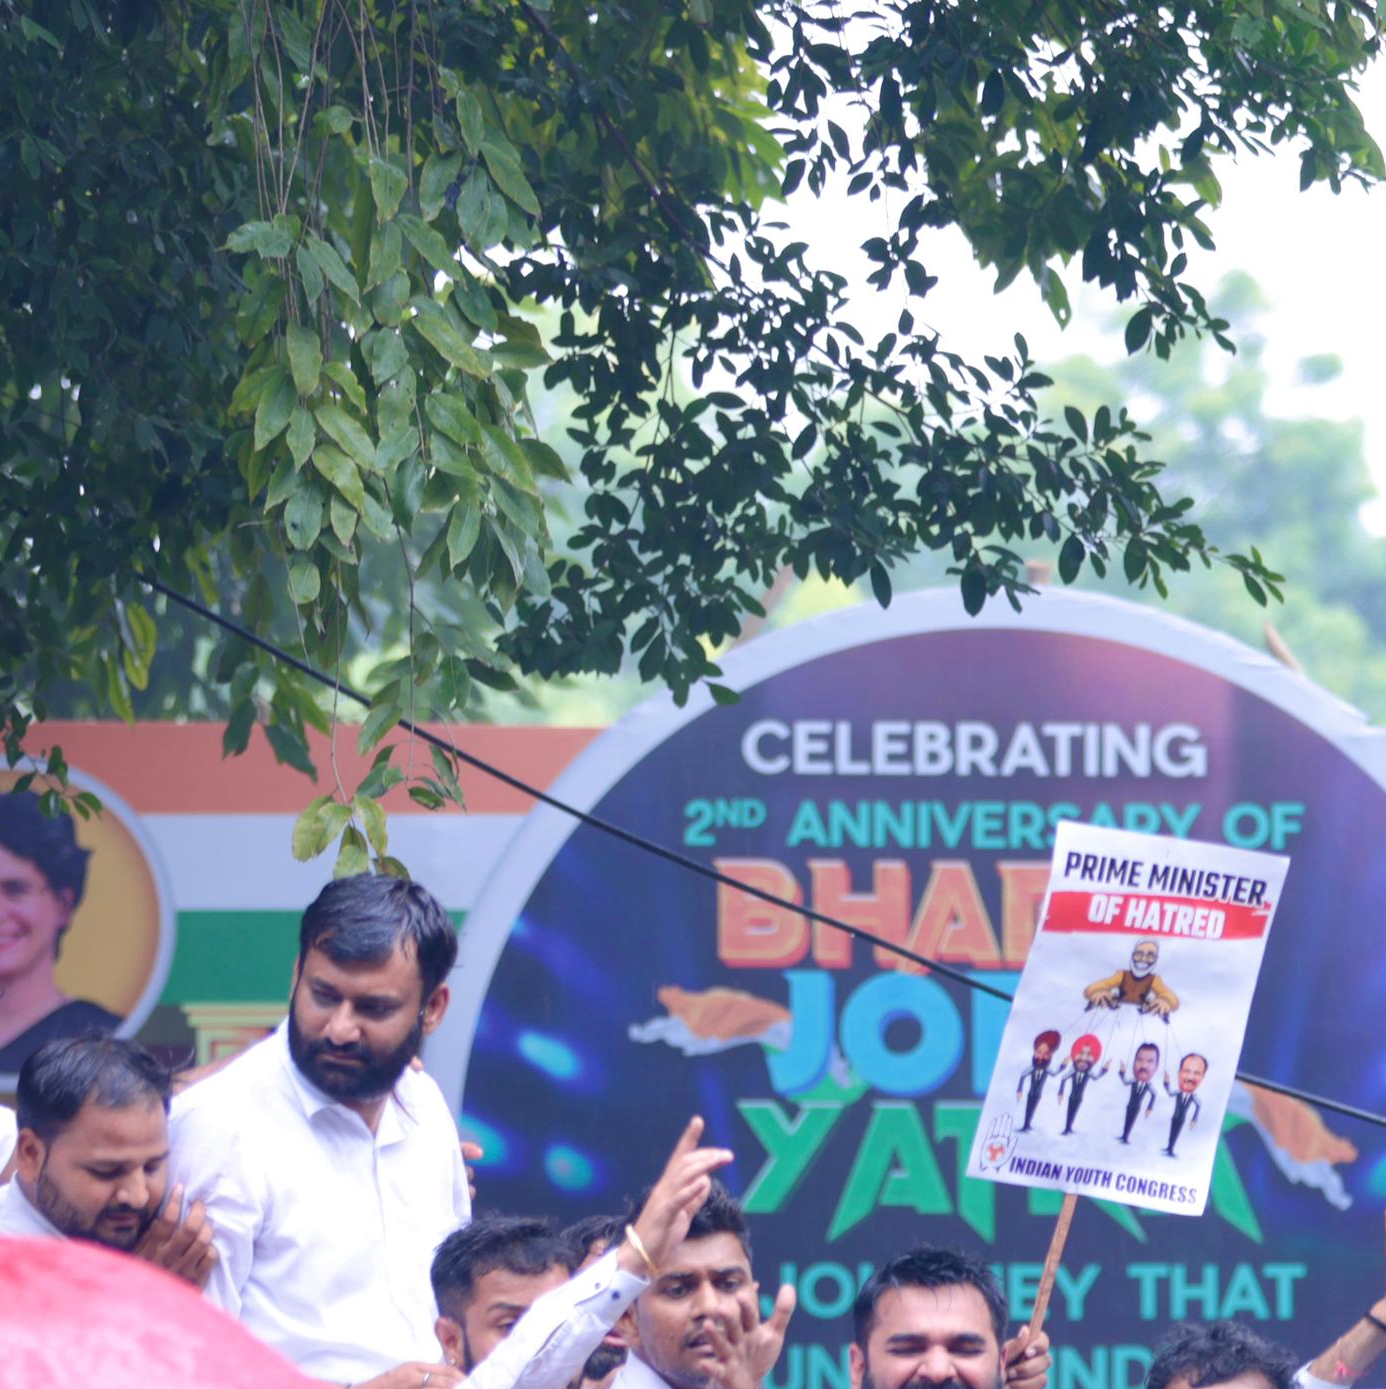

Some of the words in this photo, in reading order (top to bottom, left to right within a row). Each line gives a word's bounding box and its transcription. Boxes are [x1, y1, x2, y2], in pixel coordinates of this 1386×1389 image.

[742, 720, 1208, 777] CELEBRATING
[683, 798, 767, 847] 2ND
[1222, 802, 1305, 850] OF
[1064, 851, 1144, 887] PRIME
[1147, 862, 1268, 906] MINISTER
[1087, 894, 1123, 924] OF
[1124, 898, 1226, 940] HATRED
[1009, 1156, 1063, 1180] INDIAN
[1065, 1166, 1113, 1189] YOUTH
[1115, 1173, 1198, 1205] CONGRESS
[1126, 1262, 1308, 1322] THAT
